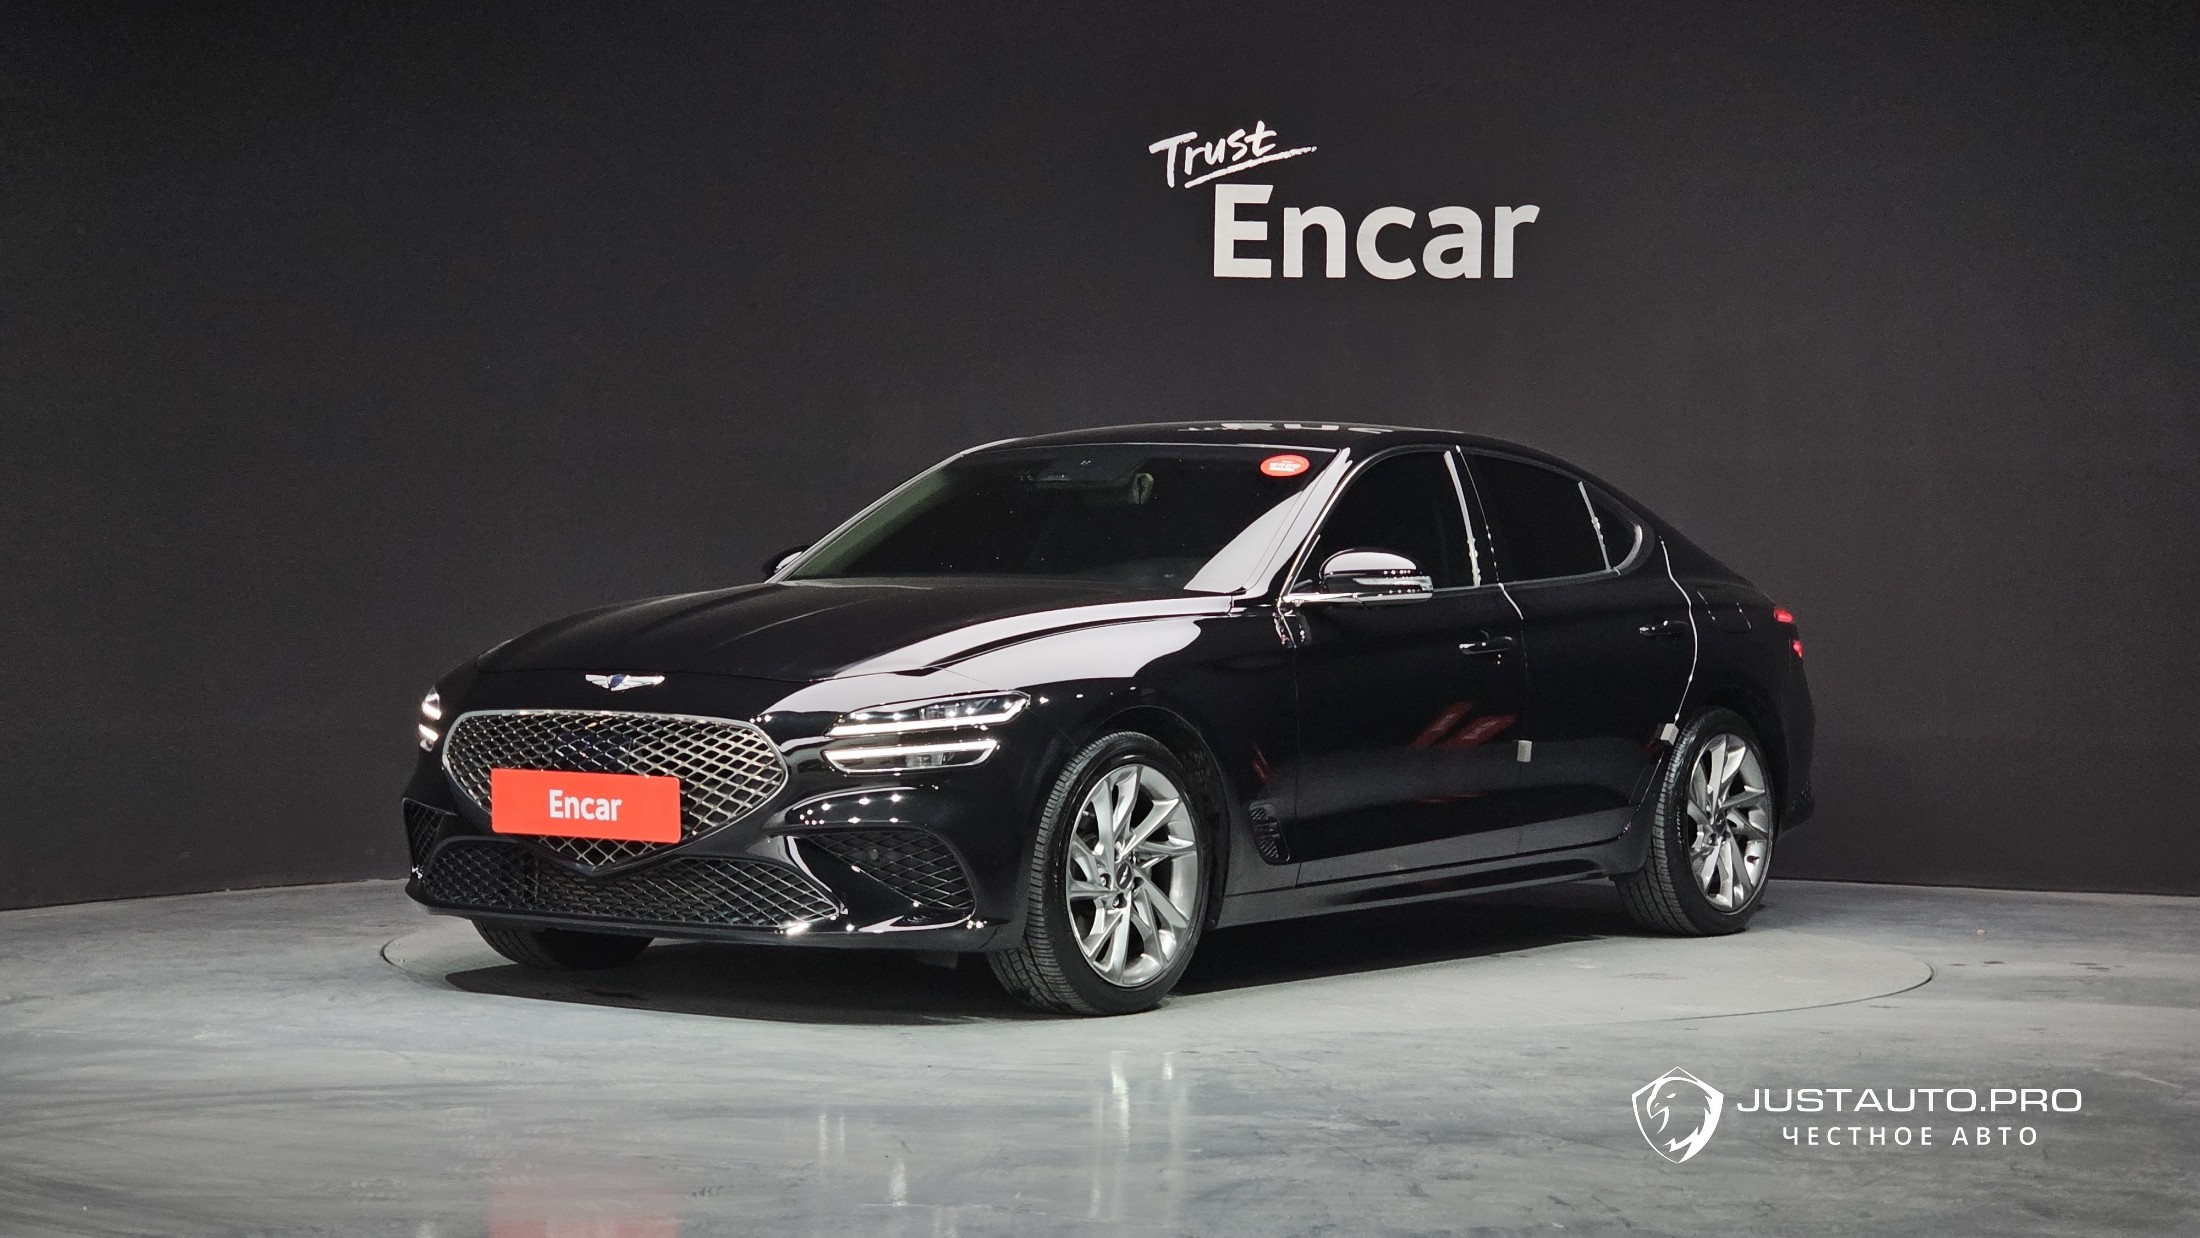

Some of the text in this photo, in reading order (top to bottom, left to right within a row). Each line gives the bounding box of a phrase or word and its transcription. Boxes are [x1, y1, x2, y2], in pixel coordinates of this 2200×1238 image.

[1148, 120, 1279, 188] Trust
[1213, 183, 1541, 280] Encar
[548, 788, 623, 822] Encar
